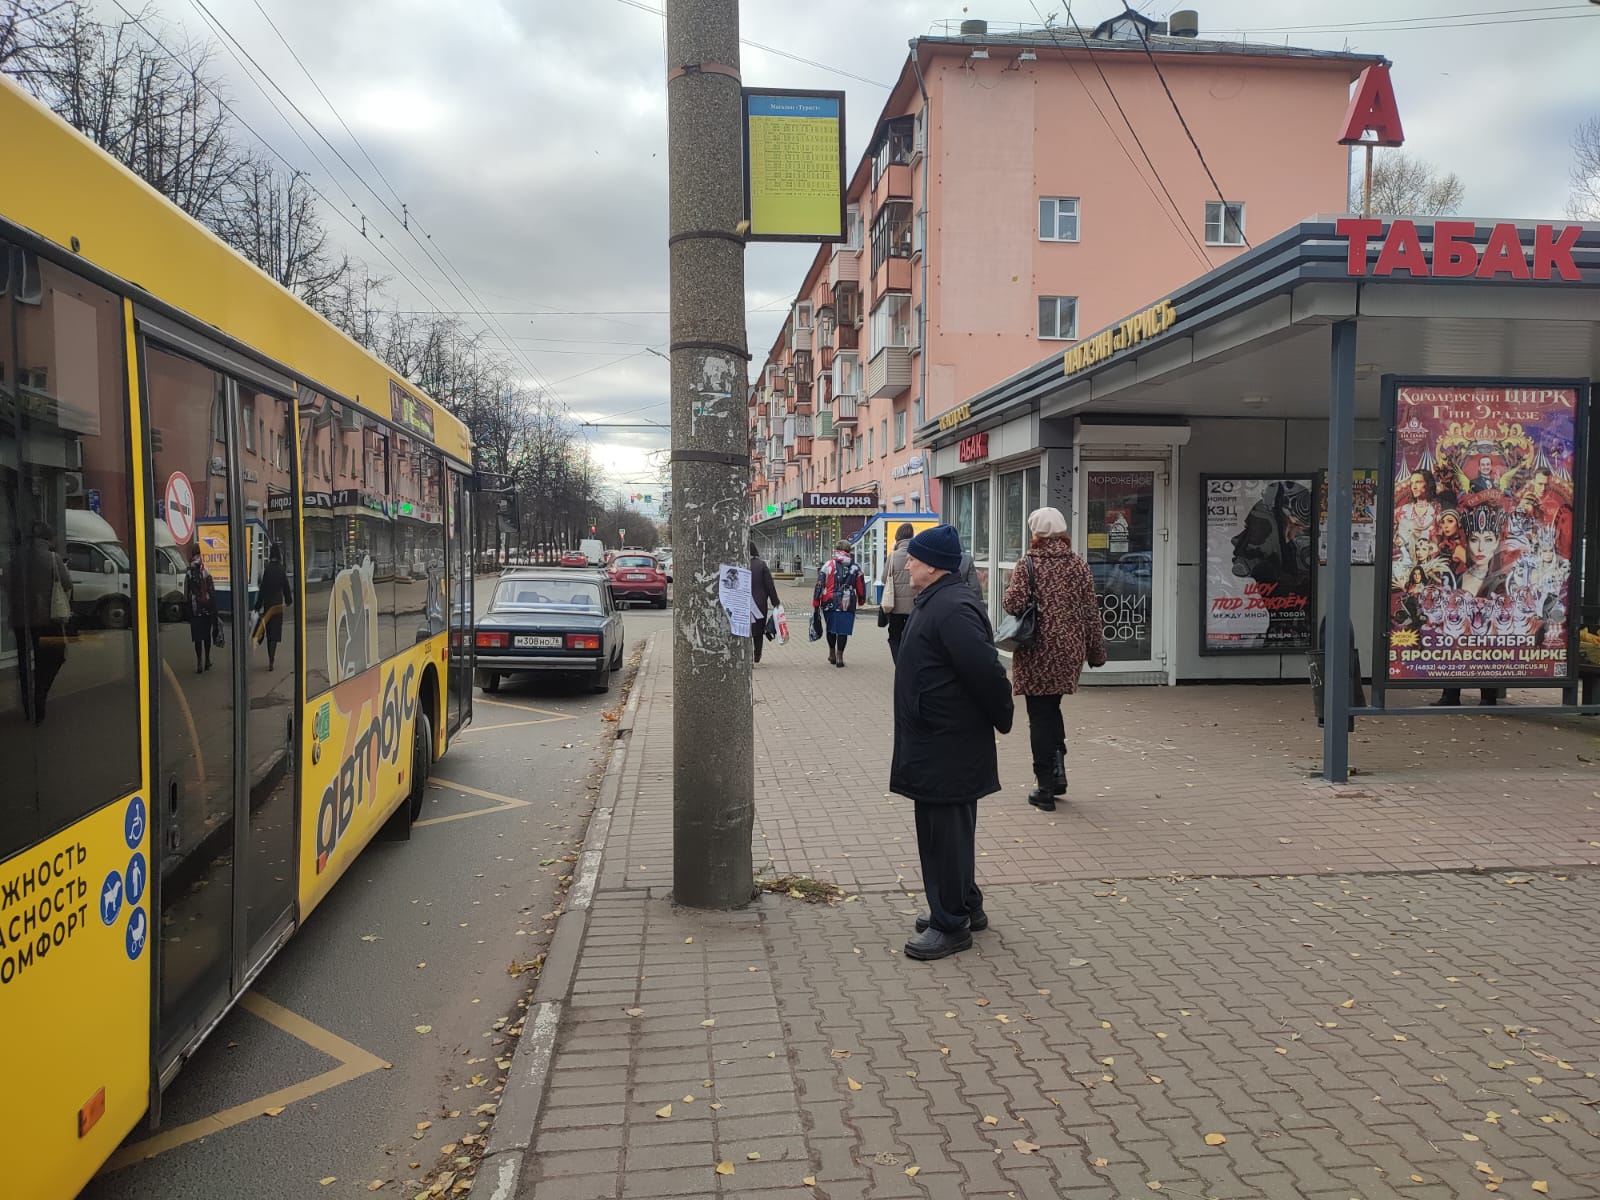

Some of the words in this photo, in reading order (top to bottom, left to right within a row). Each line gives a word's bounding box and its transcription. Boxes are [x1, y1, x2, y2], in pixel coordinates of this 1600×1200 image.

[1336, 218, 1584, 281] ТАБАК
[1064, 329, 1114, 376] МАГАЗИН
[1113, 299, 1177, 350] «ТУРИСТ»
[1504, 390, 1573, 408] ЦИРК
[1089, 475, 1152, 486] МОРОЖЕНОЕ
[1211, 481, 1235, 494] 20
[810, 494, 871, 508] Пекарня
[1207, 505, 1238, 517] КЗЦ
[1243, 582, 1279, 595] ШОУ
[1095, 594, 1146, 610] СОКИ
[1210, 597, 1243, 613] ПОД
[1245, 592, 1308, 611] ДОЖДЁМ
[1279, 609, 1306, 618] ТОБОЙ
[1102, 625, 1146, 641] ОФЕ
[1422, 636, 1432, 647] С
[1436, 636, 1453, 647] 30
[1458, 635, 1536, 647] СЕНТЯБРЯ
[1389, 650, 1397, 661] В
[1401, 649, 1515, 661] ЯРОСЛАВСКОМ
[1519, 649, 1567, 663] ЦИРКЕ
[1469, 663, 1549, 671] WWW.ROYALCIRCUS.RU
[1, 842, 87, 911] ЖНОСТЬ
[1, 904, 88, 984] ОМФОРТ
